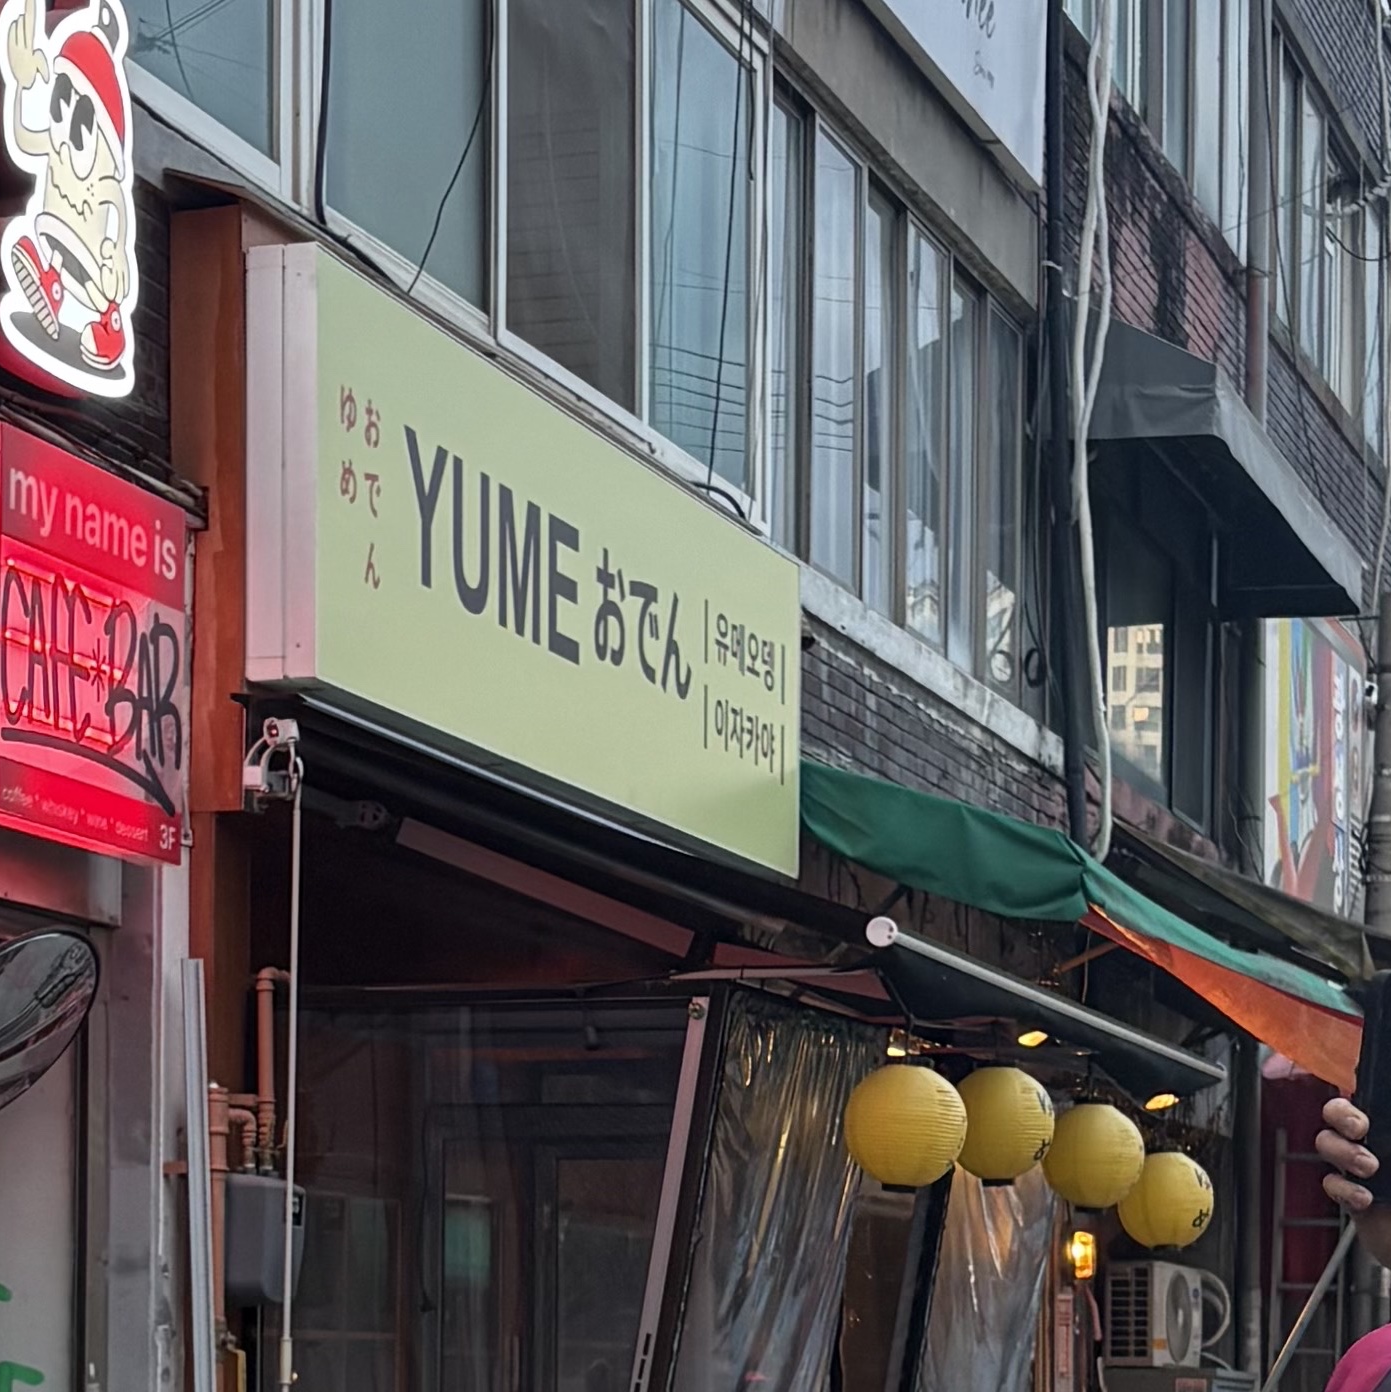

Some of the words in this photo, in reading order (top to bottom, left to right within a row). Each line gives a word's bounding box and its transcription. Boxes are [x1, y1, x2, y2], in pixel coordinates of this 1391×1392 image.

[339, 384, 358, 505] ゆめ
[363, 398, 382, 591] おでん
[9, 466, 60, 538] my
[64, 494, 148, 568] name
[153, 519, 177, 581] is
[404, 424, 580, 666] YUME
[594, 546, 692, 700] おでん
[0, 567, 93, 744] CAFE
[104, 598, 182, 771] BAR
[714, 611, 776, 692] 유메오뎅
[714, 698, 775, 774] 이자카야
[159, 824, 176, 850] 3F
